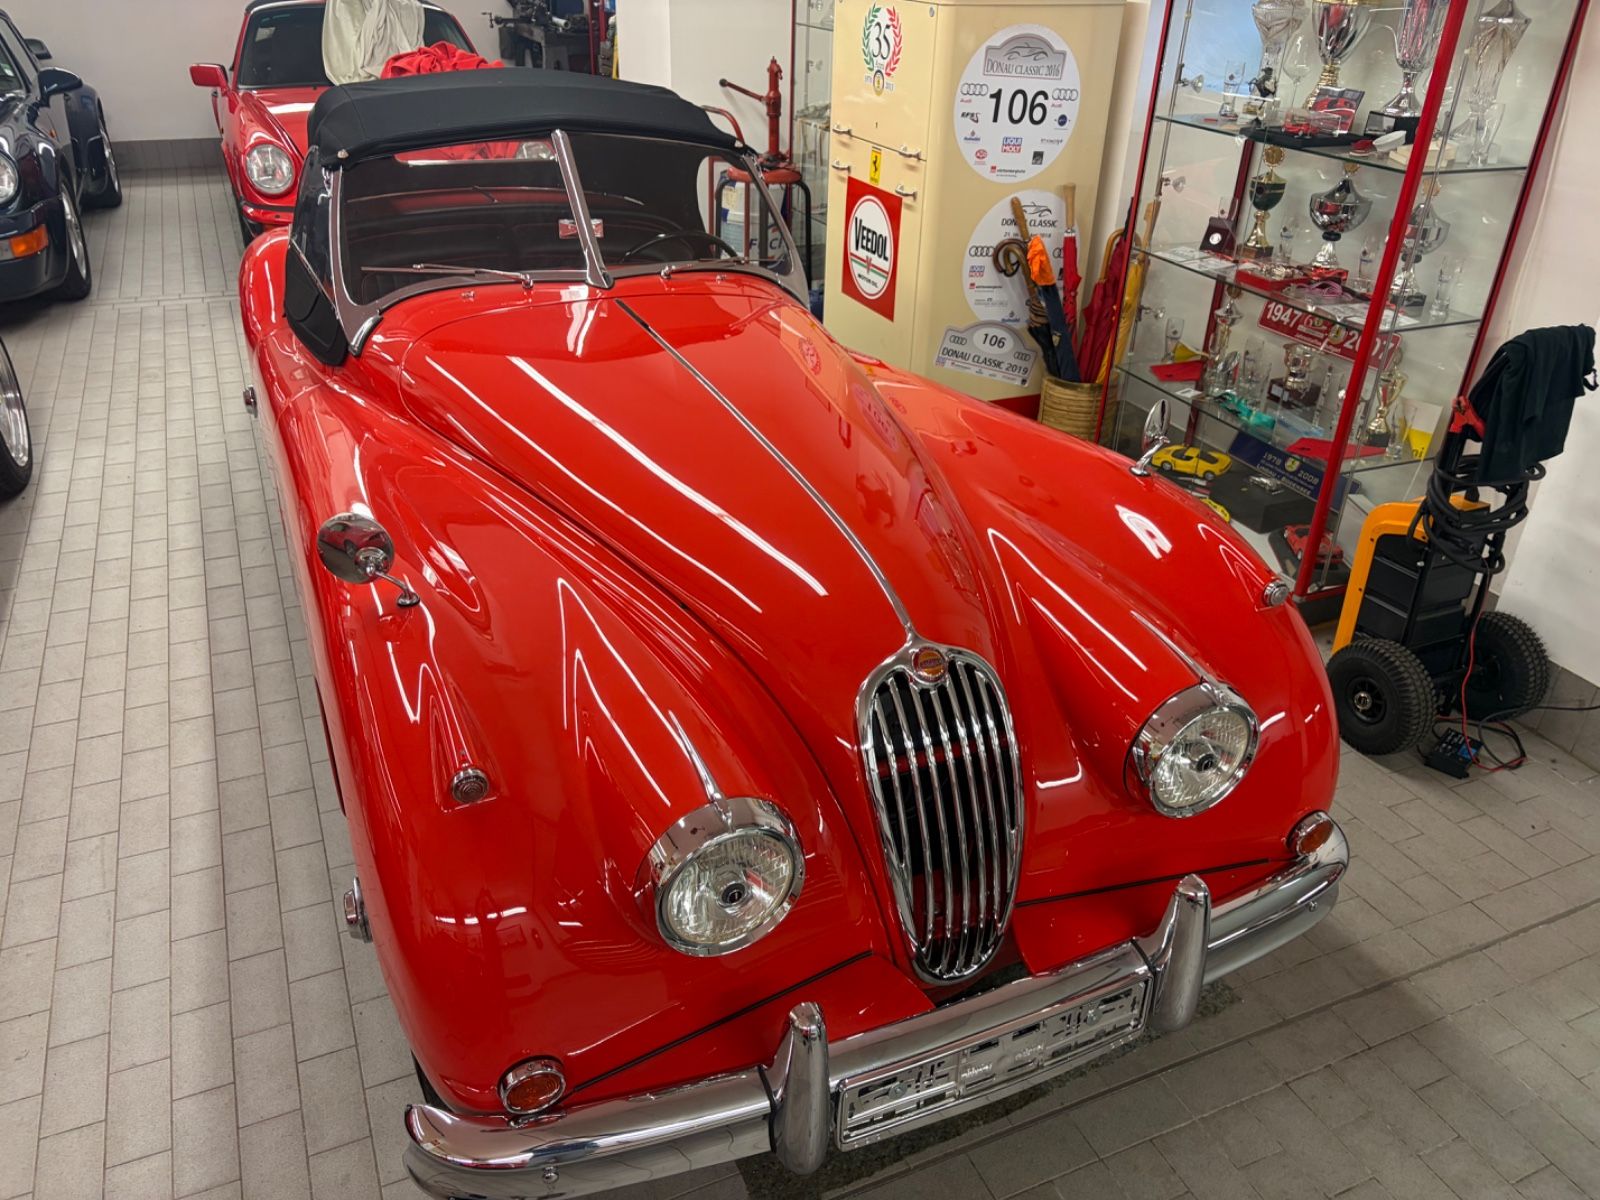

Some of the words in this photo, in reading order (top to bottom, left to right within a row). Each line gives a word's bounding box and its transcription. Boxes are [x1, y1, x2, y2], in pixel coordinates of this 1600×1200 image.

[872, 21, 891, 60] 35
[986, 58, 1013, 73] DONAU
[1014, 64, 1044, 76] CLASSIC
[989, 88, 1048, 125] 106
[855, 216, 888, 262] VEEDOL
[1029, 219, 1057, 227] CLASSIC
[982, 333, 1006, 349] 106
[1266, 301, 1302, 328] 1947
[1343, 328, 1394, 360] 27
[941, 347, 970, 361] DONAU
[972, 354, 1005, 370] CLASSIC
[1005, 362, 1029, 376] 2019
